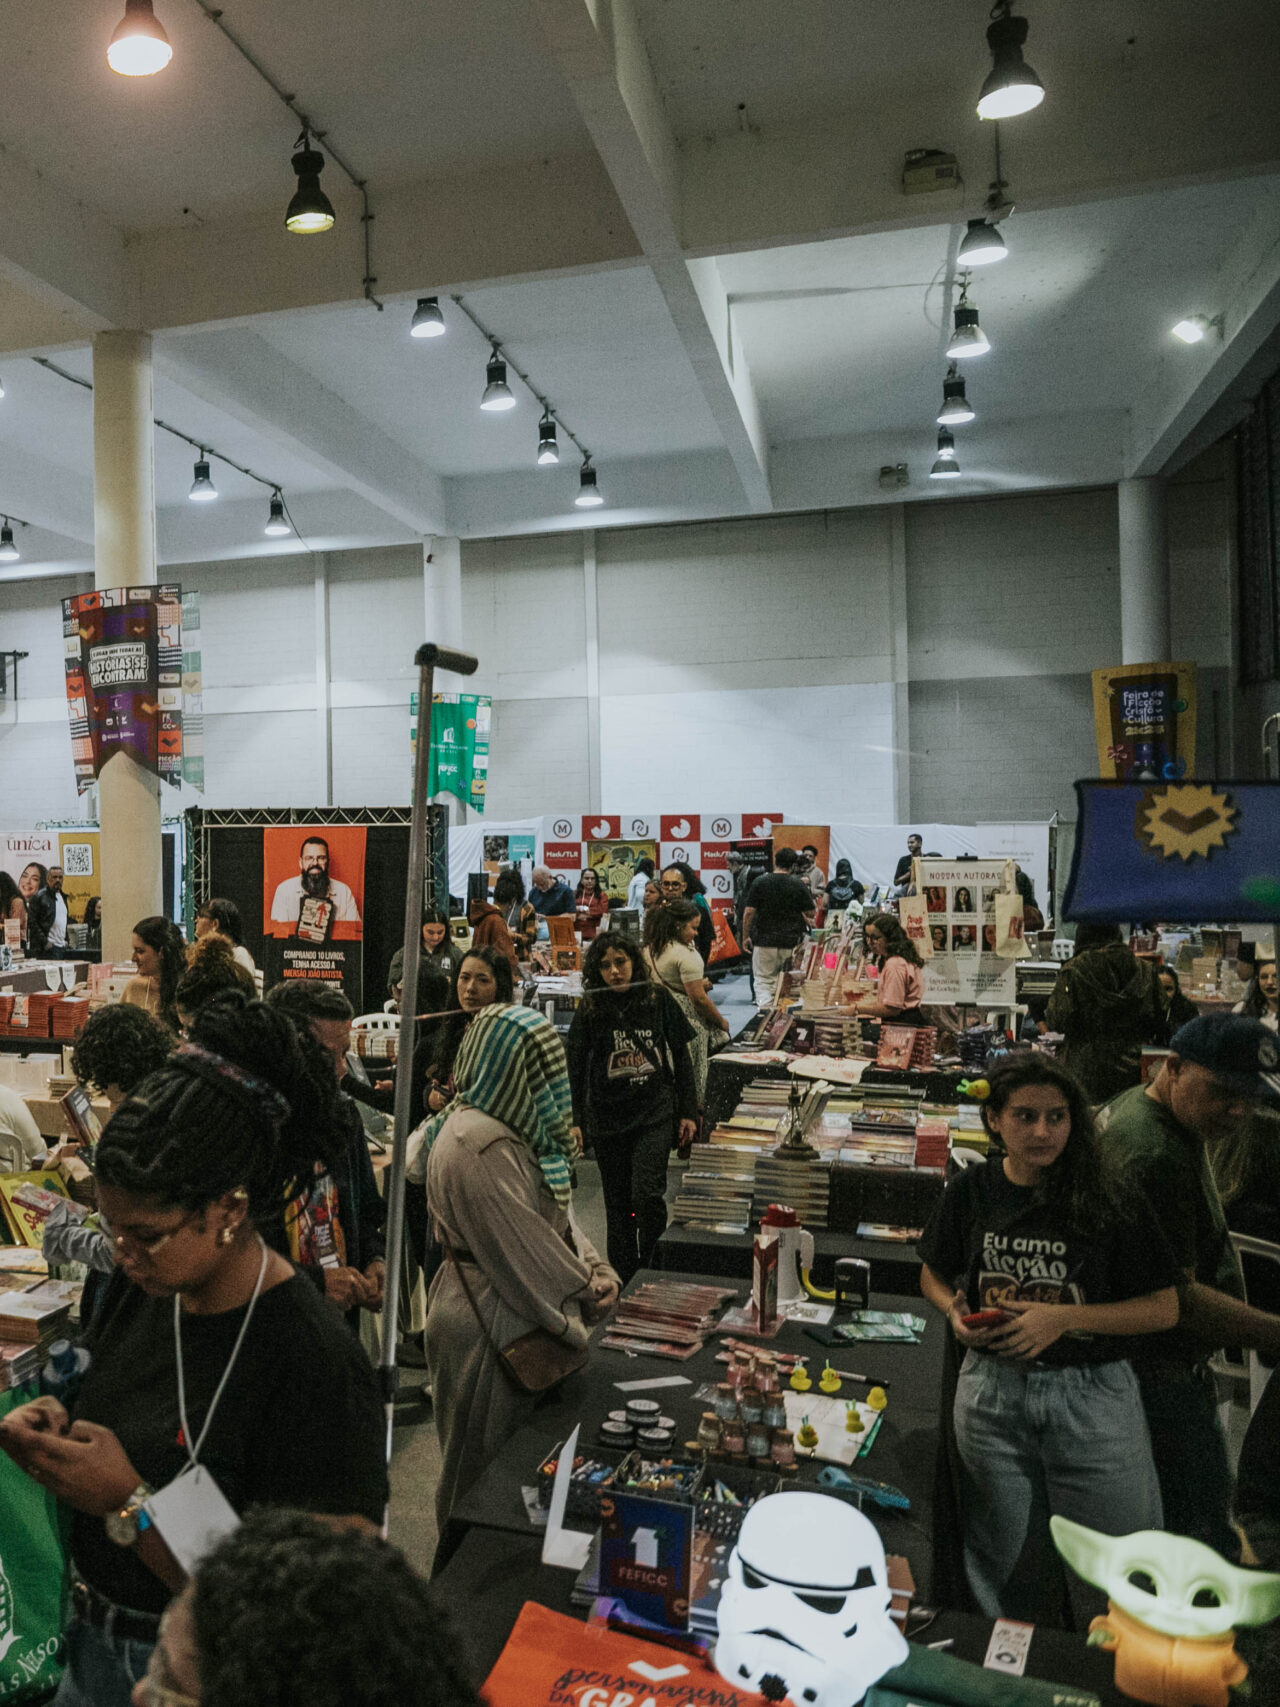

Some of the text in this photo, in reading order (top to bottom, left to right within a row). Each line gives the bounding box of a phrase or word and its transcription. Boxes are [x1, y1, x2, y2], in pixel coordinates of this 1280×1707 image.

[134, 656, 147, 669] SE
[92, 669, 145, 685] ENCONTRAM
[930, 872, 1001, 880] NOSSAS AUTORAS
[284, 950, 316, 959] COMPRANDO
[318, 951, 324, 960] 10
[292, 960, 336, 969] TENHA ACESSO A
[613, 1030, 626, 1038] Eu
[983, 1232, 1066, 1256] Eu amo
[982, 1248, 1068, 1282] ficção
[618, 1565, 668, 1586] FEFICC
[16, 1634, 63, 1684] NELSO
